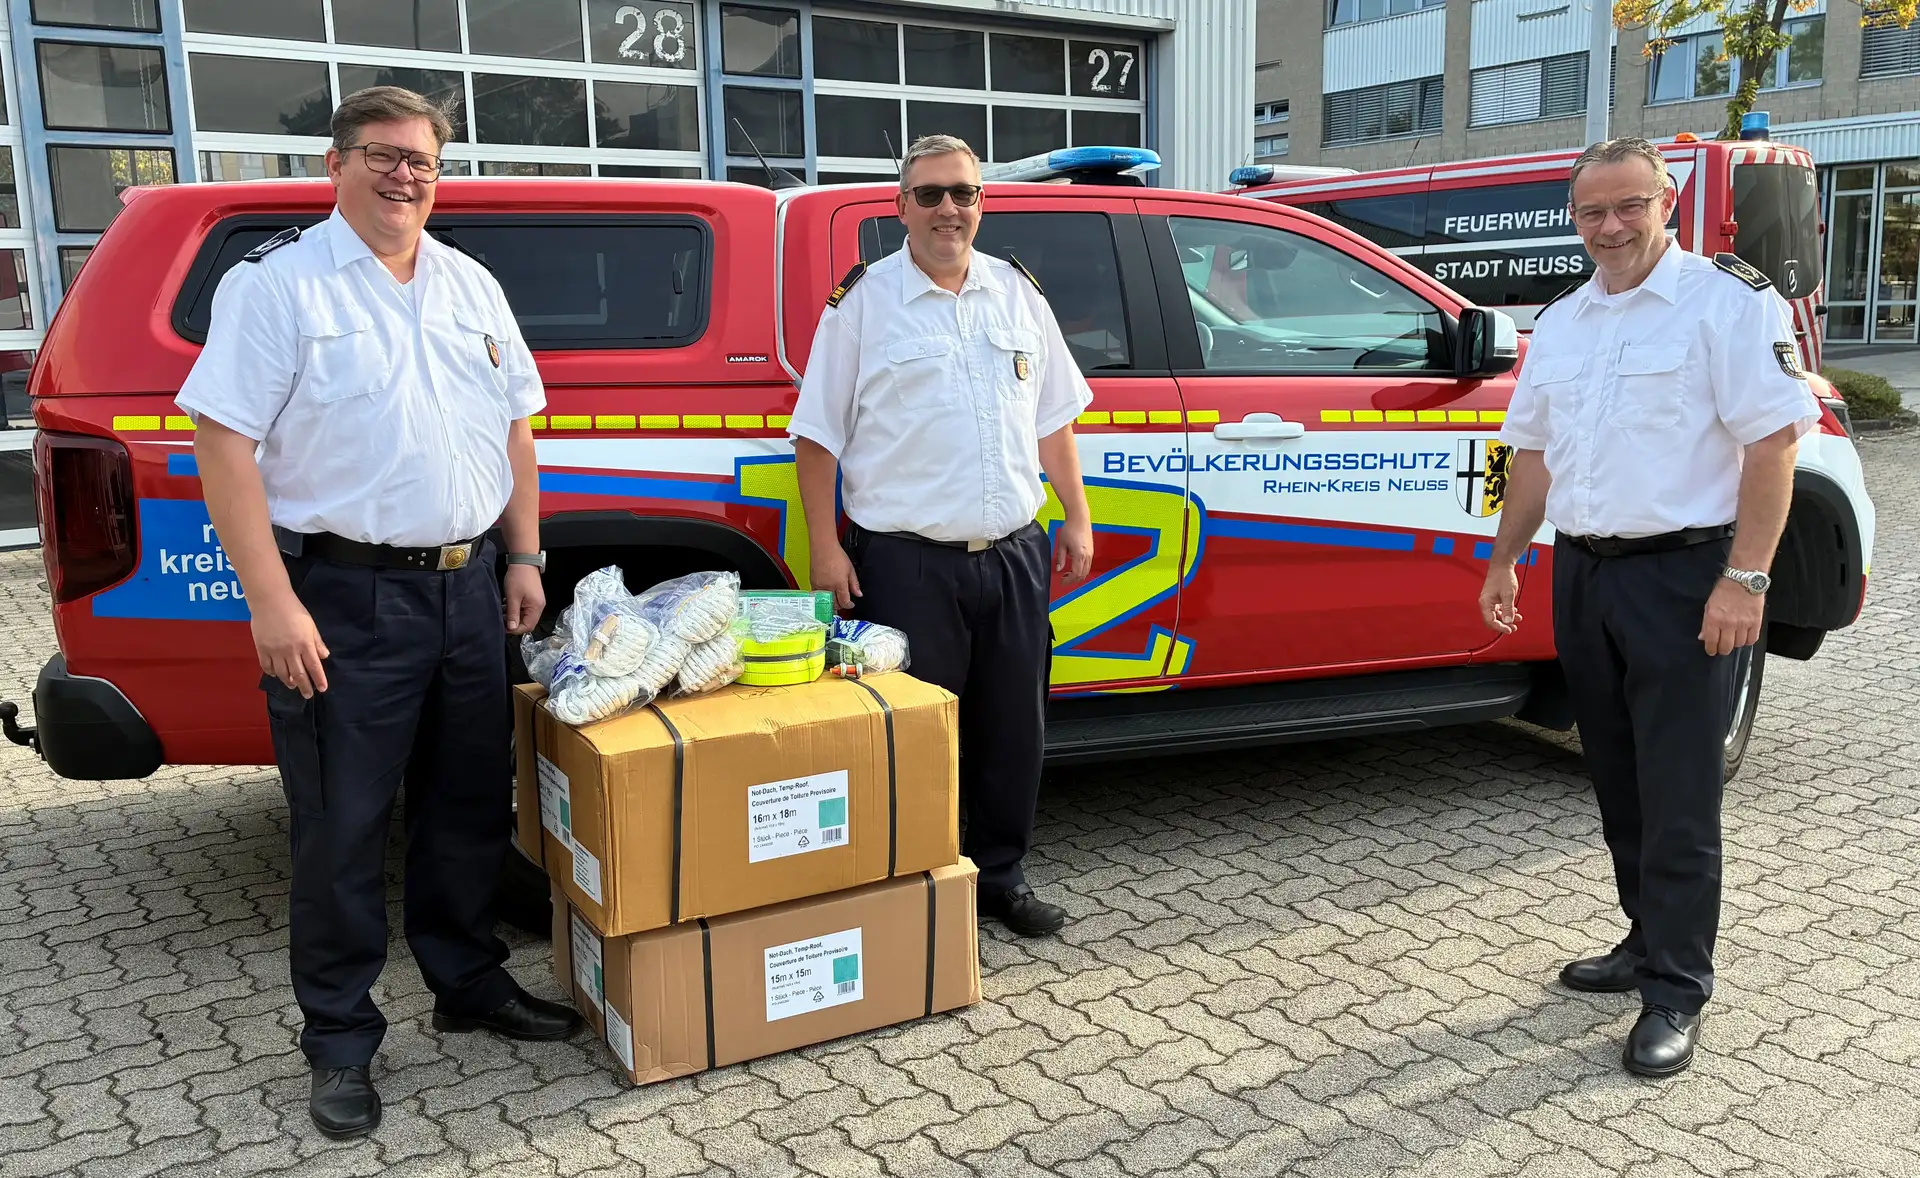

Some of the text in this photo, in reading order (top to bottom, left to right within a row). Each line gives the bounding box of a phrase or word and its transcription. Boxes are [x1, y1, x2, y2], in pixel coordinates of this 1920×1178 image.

[615, 6, 686, 62] 28
[1088, 48, 1134, 93] 27
[1434, 255, 1584, 280] STADT NEUSS
[188, 580, 245, 601] neu
[752, 797, 781, 807] Couverture
[790, 792, 809, 800] Toiture
[810, 787, 836, 797] Provisoire
[753, 813, 771, 824] 16m
[779, 809, 797, 819] 18m
[769, 958, 797, 969] Couverture
[823, 946, 848, 957] Provisoire
[770, 974, 787, 984] 15m
[796, 968, 812, 978] 15m
